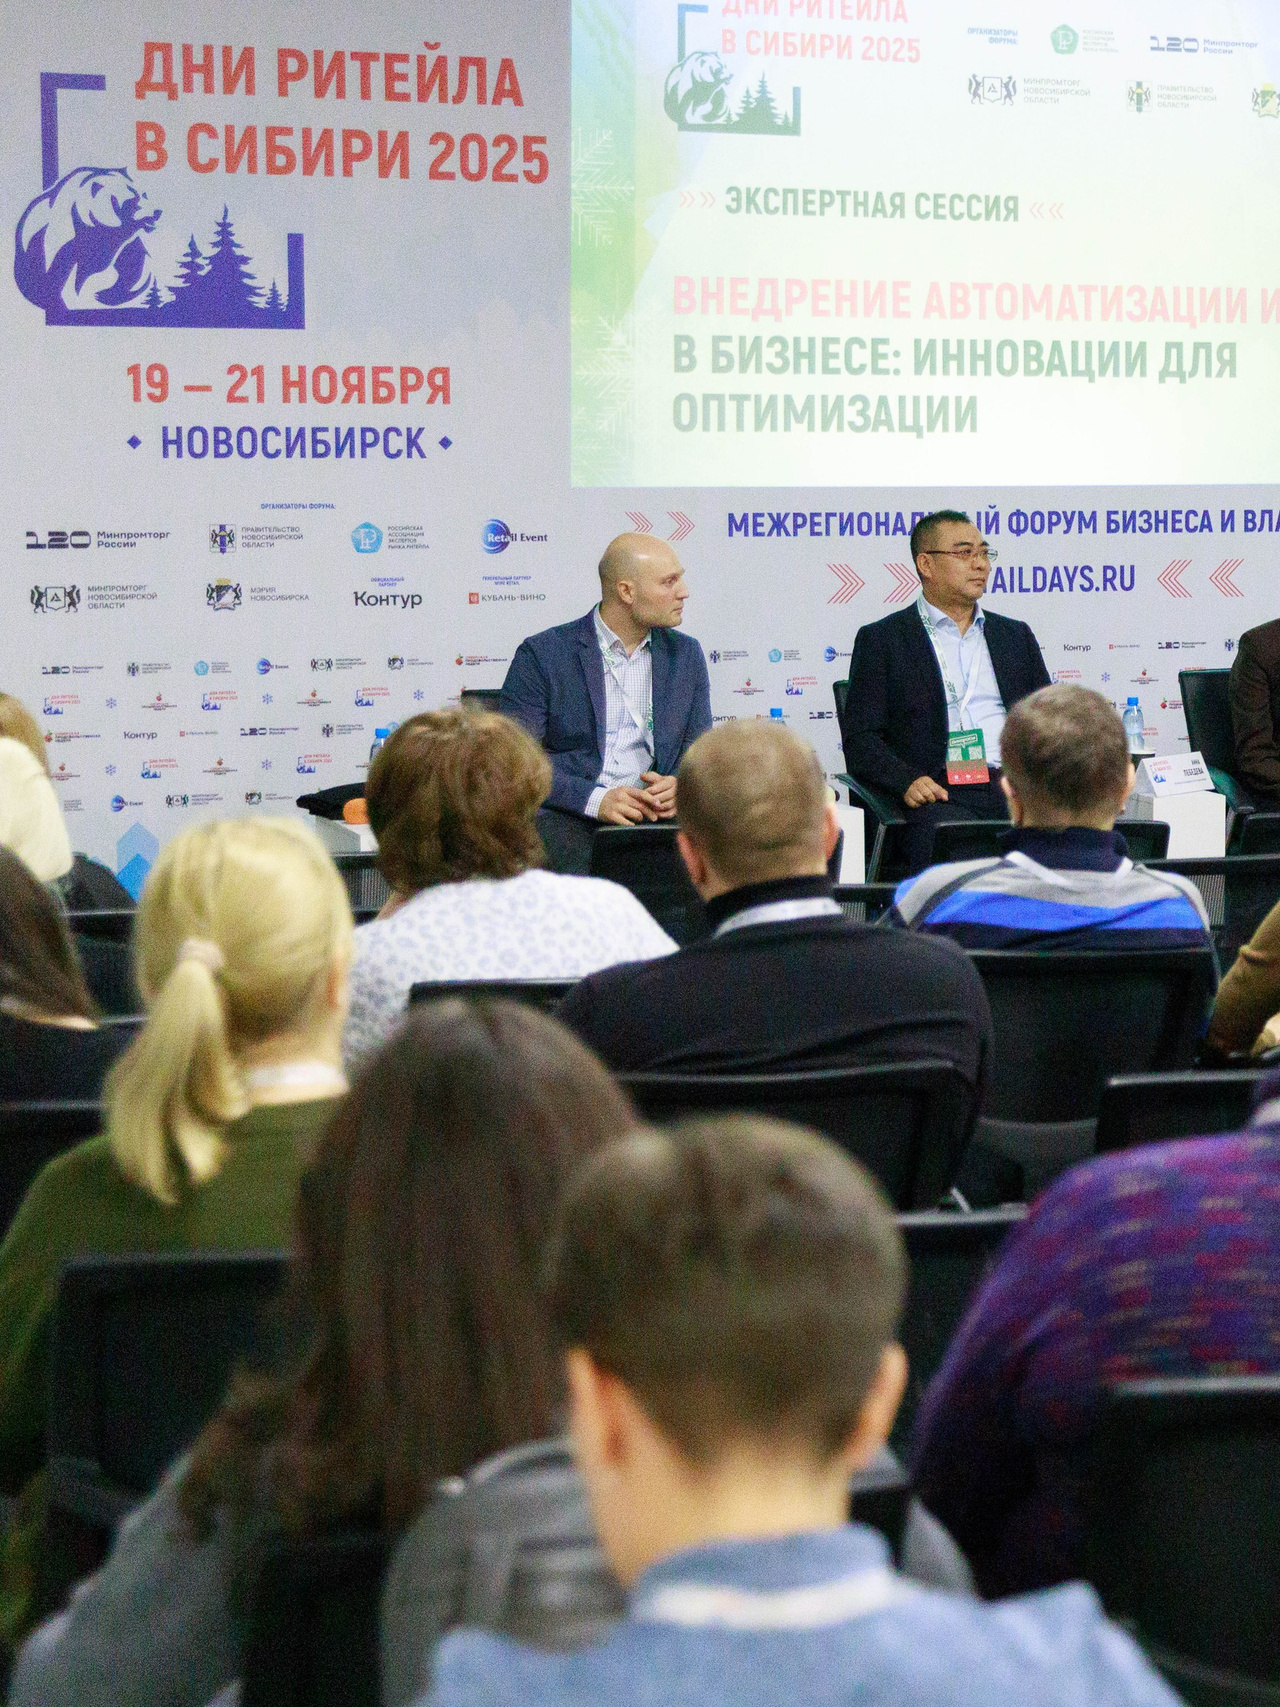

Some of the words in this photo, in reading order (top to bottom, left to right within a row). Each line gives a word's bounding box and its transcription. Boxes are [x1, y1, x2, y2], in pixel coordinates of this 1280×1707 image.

[967, 28, 1018, 37] ОРГАНИЗАТОРЫ
[722, 29, 736, 54] В
[746, 30, 853, 59] СИБИРИ
[861, 36, 920, 63] 2025
[989, 37, 1018, 45] ФОРУМА:
[1203, 39, 1258, 49] Минпромторг
[1203, 46, 1233, 55] России
[135, 41, 256, 100] ДНИ
[277, 41, 524, 107] РИТЕЙЛА
[1024, 78, 1081, 87] МИНПРОМТОРГ
[1024, 87, 1091, 96] НОВОСИБИРСКОЙ
[1024, 96, 1060, 104] ОБЛАСТИ
[135, 121, 168, 171] В
[186, 122, 410, 180] СИБИРИ
[428, 131, 549, 184] 2025
[725, 186, 907, 219] ЭКСПЕРТНАЯ
[915, 190, 1019, 222] СЕССИЯ
[674, 276, 911, 321] ВНЕДРЕНИЕ
[923, 281, 1247, 328] АВТОМАТИЗАЦИИ
[674, 335, 695, 373] В
[710, 335, 902, 376] БИЗНЕСЕ:
[913, 338, 1148, 382] ИННОВАЦИИ
[1159, 340, 1237, 384] ДЛЯ
[127, 363, 168, 402] 19
[227, 364, 265, 403] 21
[282, 365, 451, 405] НОЯБРЯ
[674, 393, 978, 438] ОПТИМИЗАЦИИ
[161, 426, 427, 459] НОВОСИБИРСК
[728, 505, 1000, 537] МЕЖРЕГИОНАЛЙ
[1008, 509, 1097, 537] ФОРУМ
[1106, 510, 1213, 534] БИЗНЕСА
[1221, 510, 1235, 532] И
[26, 530, 91, 550] 120
[97, 530, 170, 542] Минпромторг
[241, 533, 304, 541] НОВОСИБИРСКОЙ
[520, 532, 548, 542] Event
[97, 539, 137, 548] России
[983, 565, 1135, 593] AILDAYS.RU
[88, 592, 158, 601] НОВОСИБИРСКОЙ
[353, 591, 423, 609] Контур
[88, 602, 126, 610] ОБЛАСТИ
[1063, 643, 1091, 653] Контур
[123, 731, 158, 740] Контур
